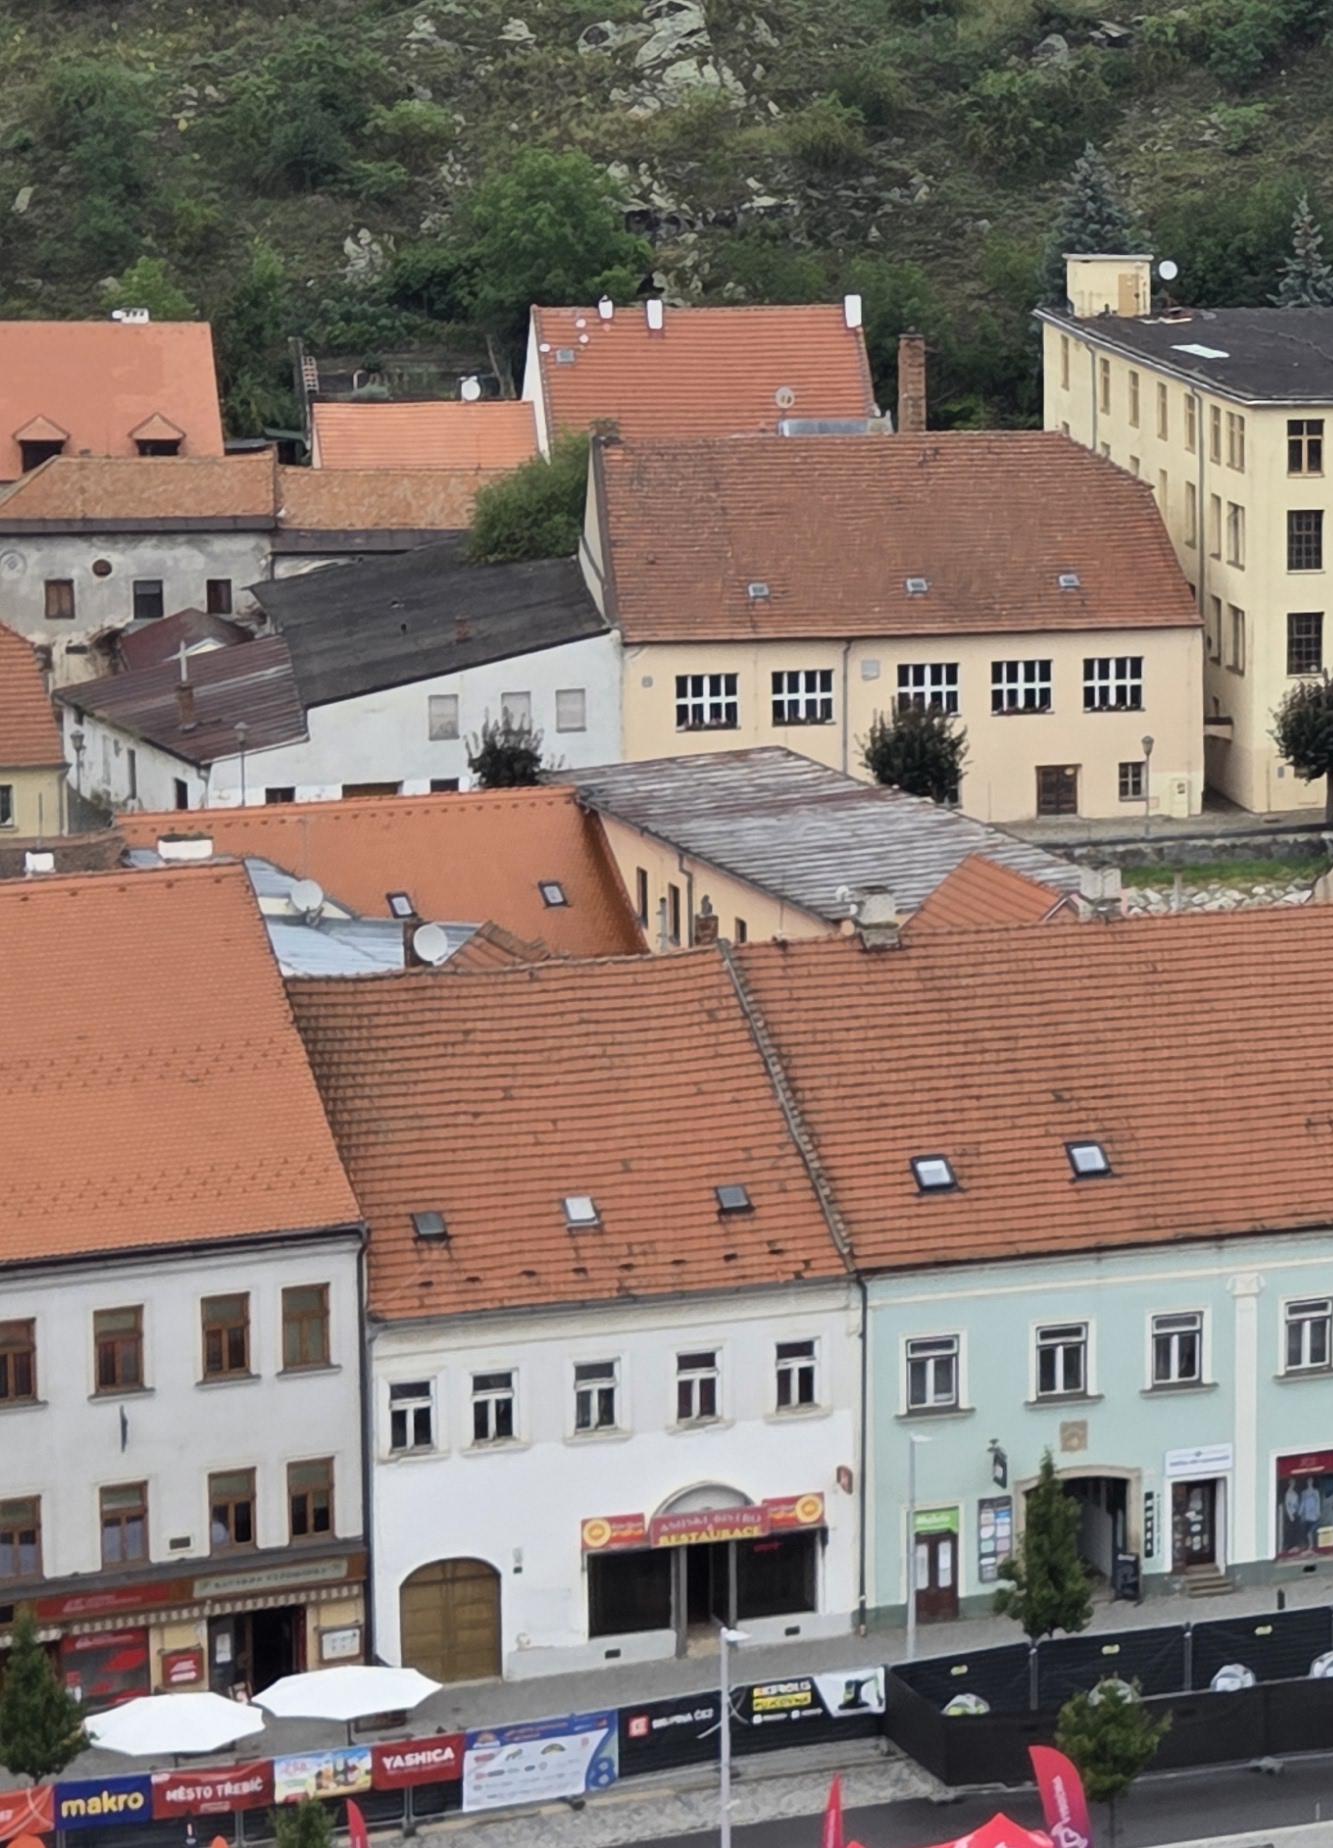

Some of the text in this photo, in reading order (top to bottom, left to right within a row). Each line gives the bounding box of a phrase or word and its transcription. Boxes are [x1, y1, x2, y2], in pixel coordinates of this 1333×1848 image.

[658, 1525, 763, 1546] RESTAURACE
[382, 1746, 456, 1770] YASHICA
[165, 1777, 263, 1802] MĚSTO TŘEBÍČ
[60, 1790, 145, 1819] makro
